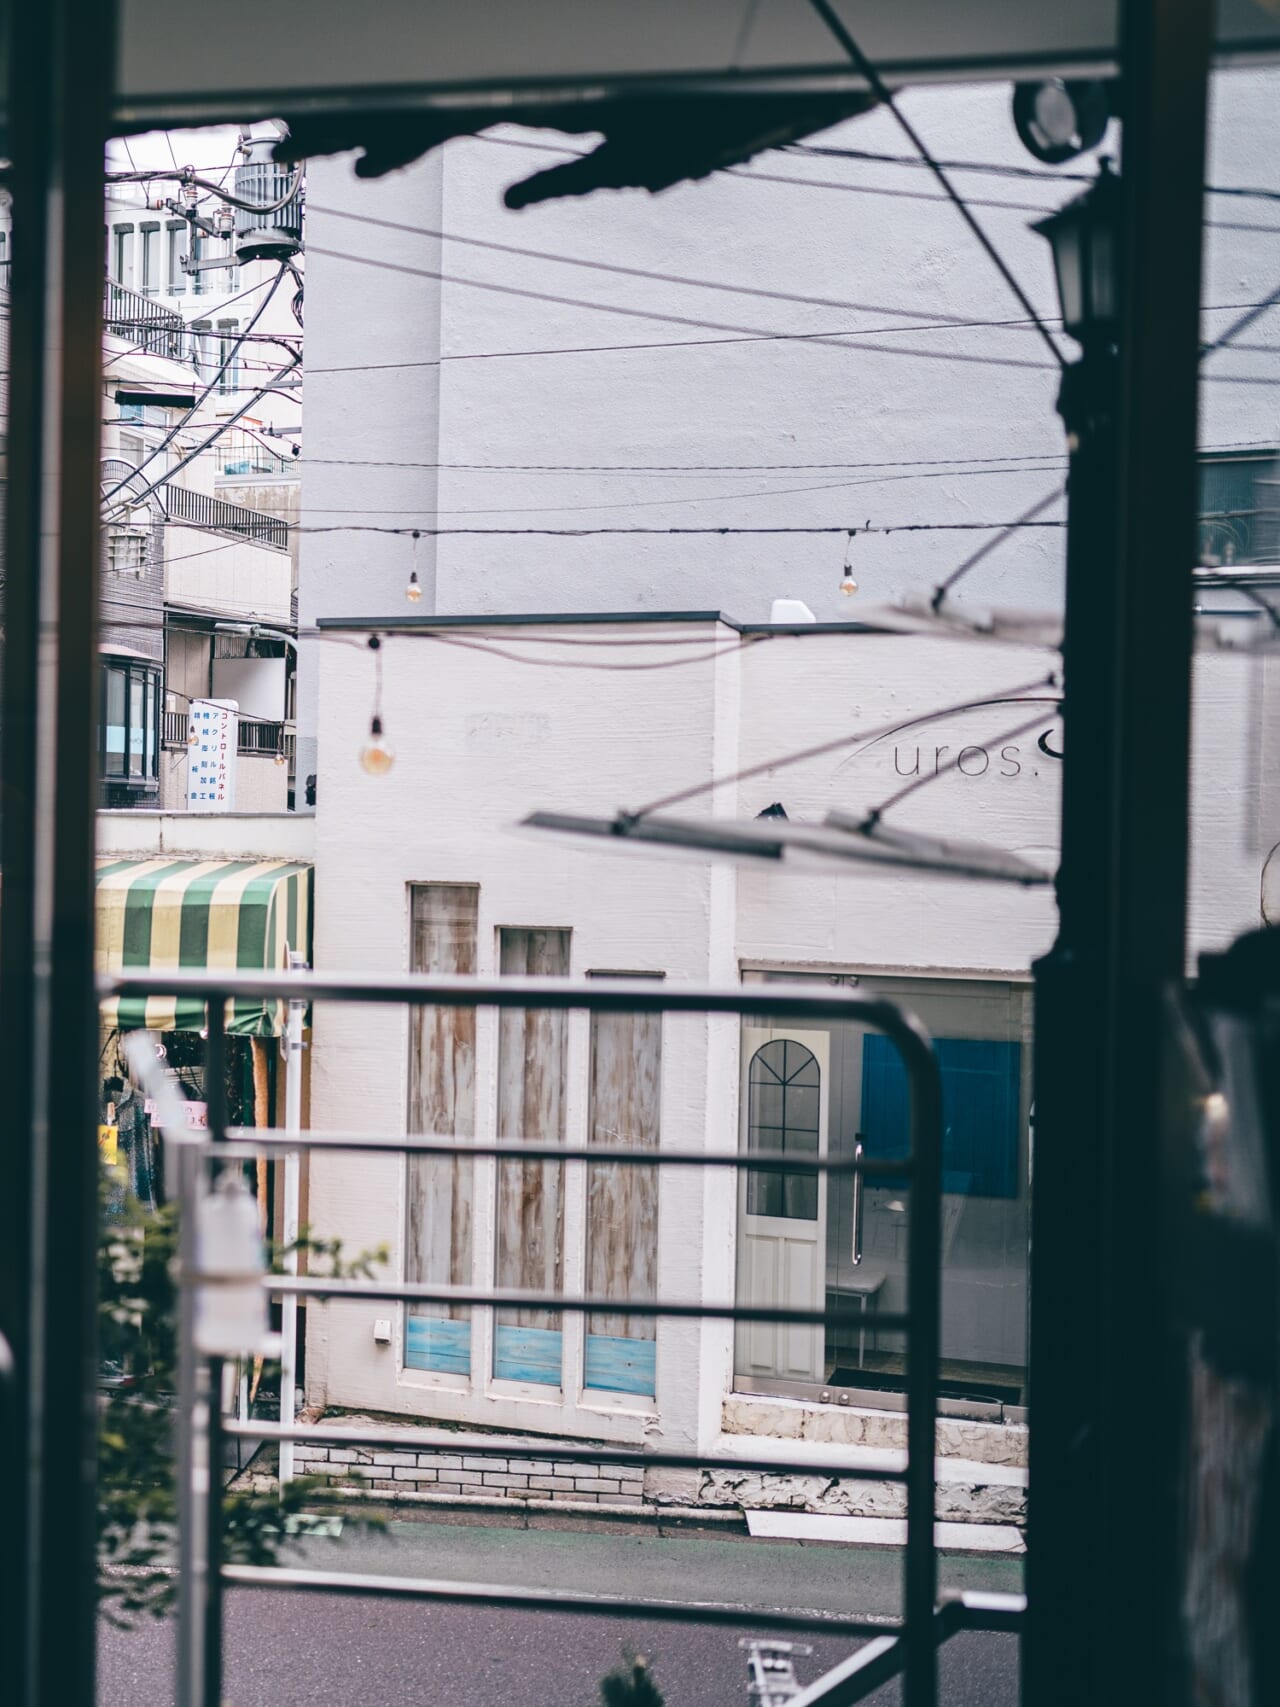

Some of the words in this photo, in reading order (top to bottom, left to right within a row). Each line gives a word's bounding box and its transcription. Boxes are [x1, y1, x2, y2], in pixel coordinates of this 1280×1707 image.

[217, 711, 228, 801] コントロールパネル
